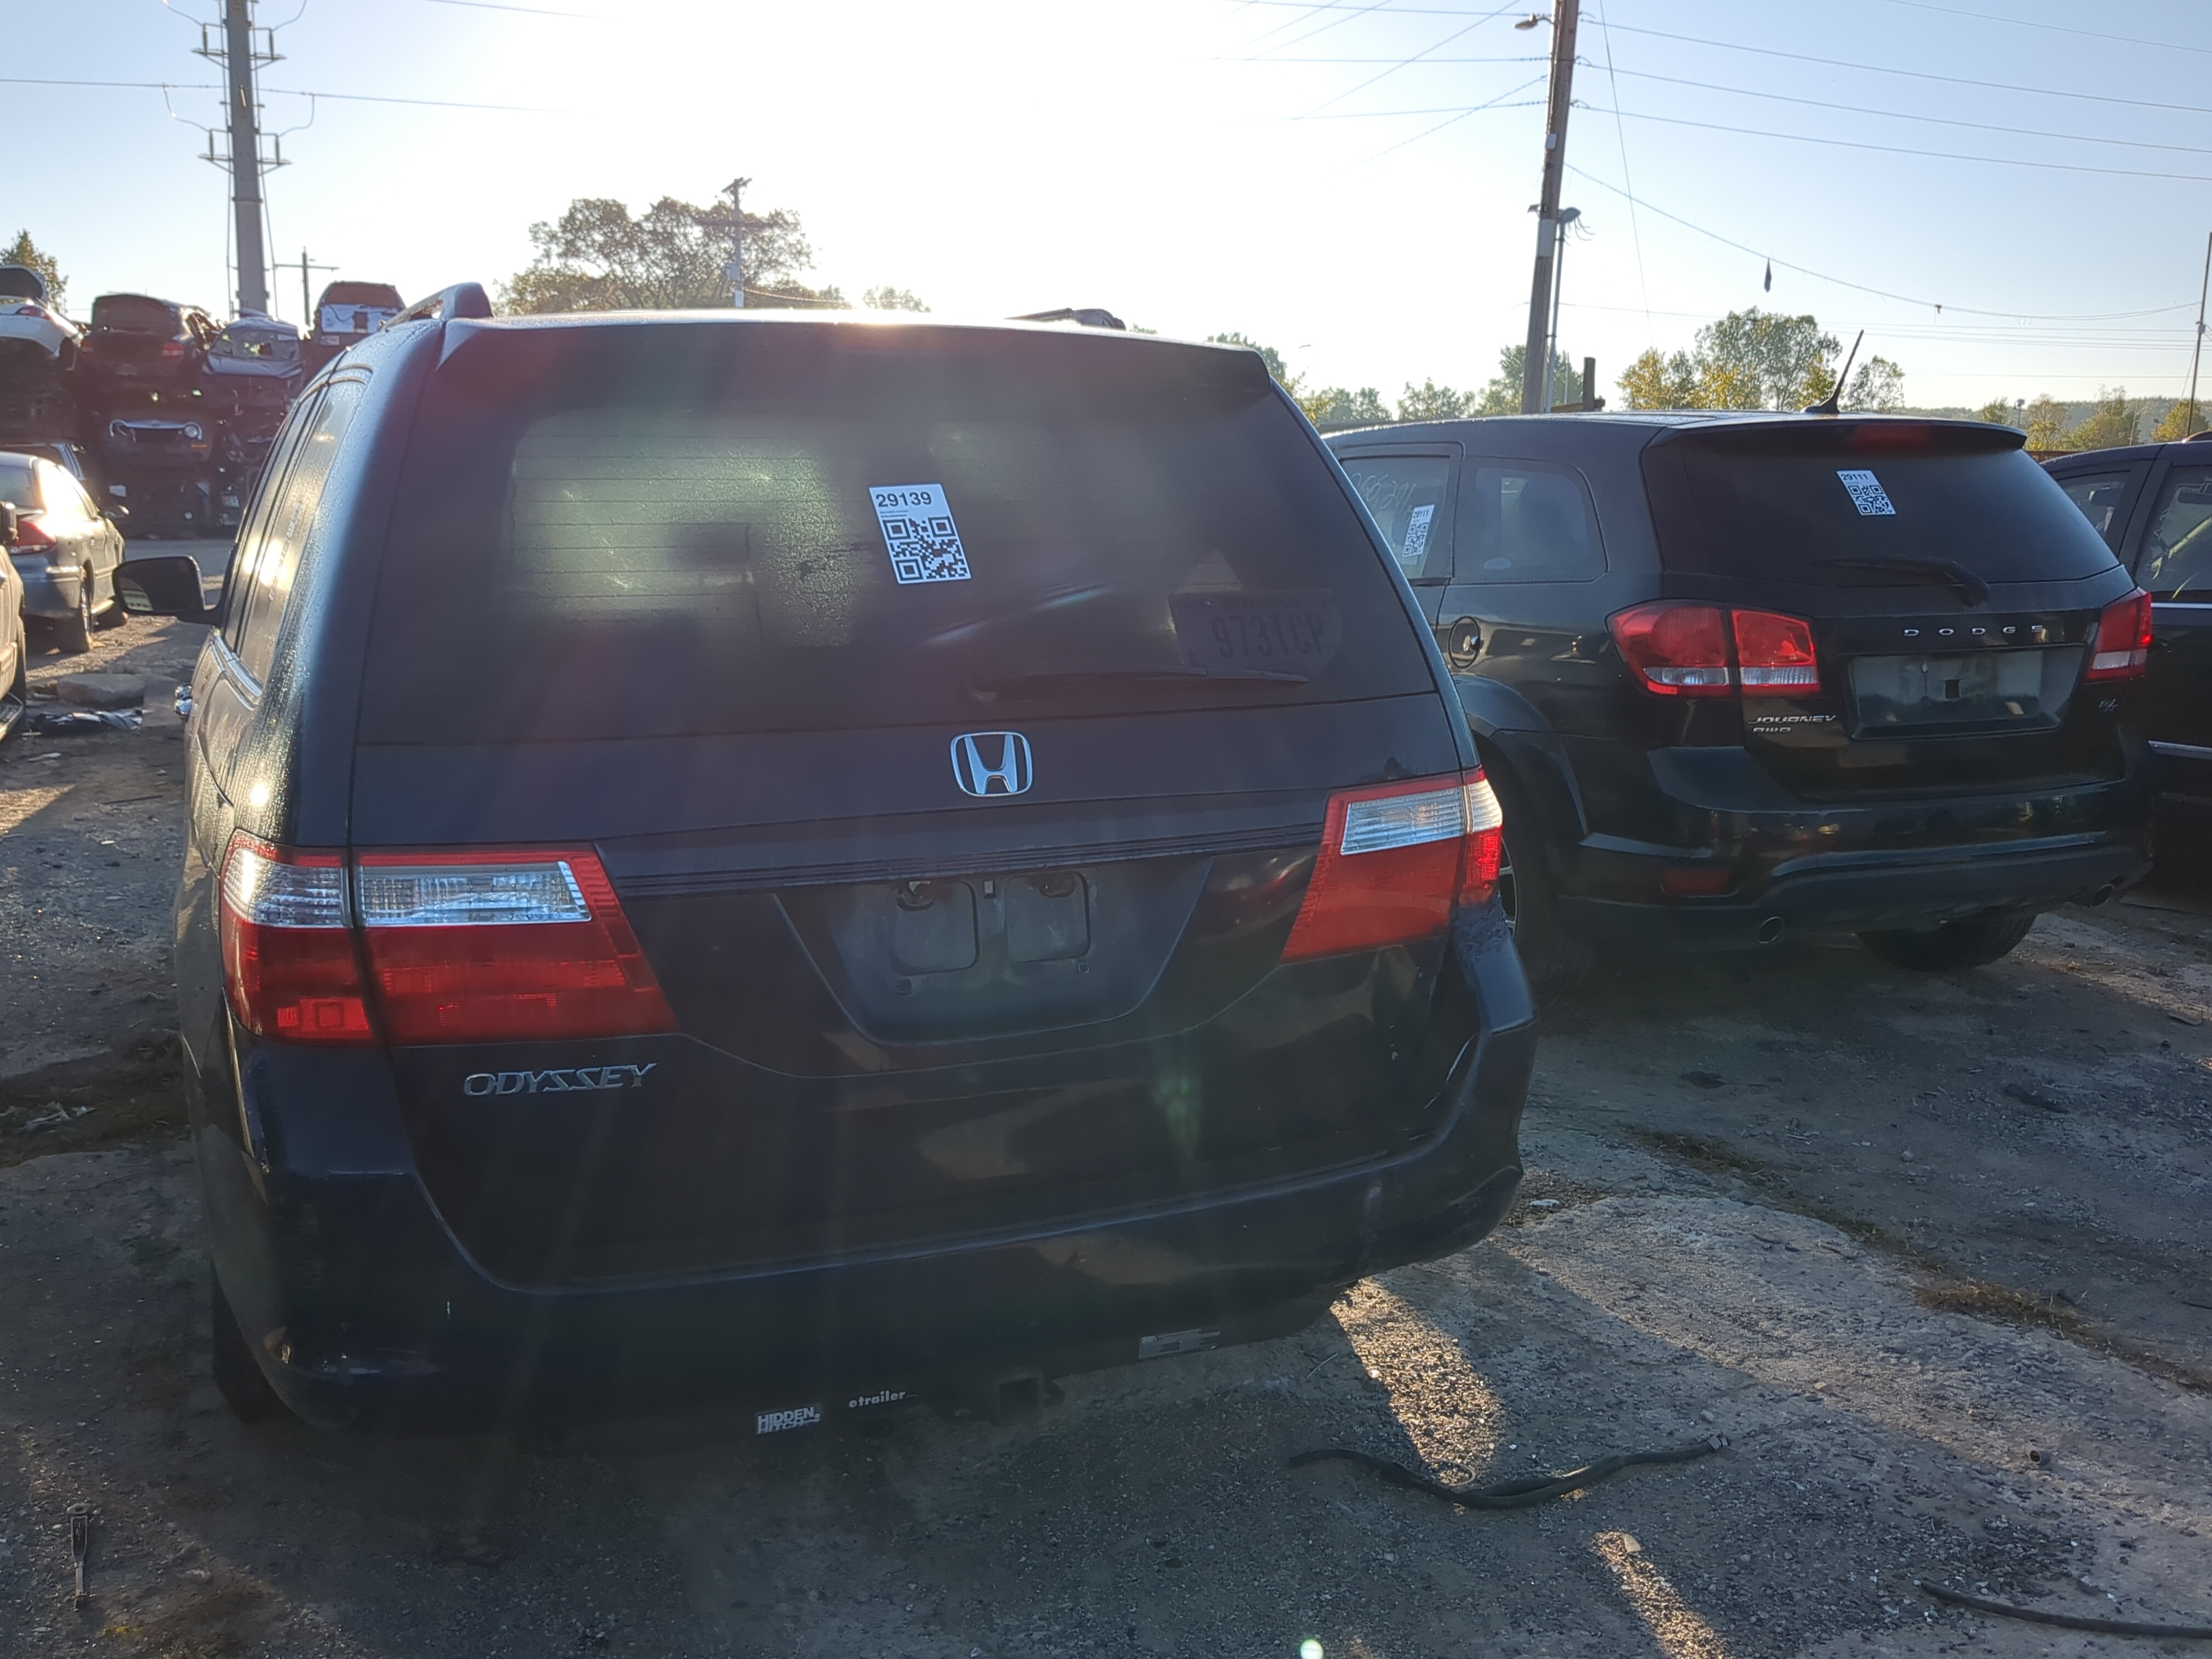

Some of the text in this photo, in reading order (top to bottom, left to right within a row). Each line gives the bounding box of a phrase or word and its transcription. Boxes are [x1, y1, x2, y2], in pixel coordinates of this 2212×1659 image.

[876, 492, 933, 507] 29139
[1904, 625, 2043, 636] DODGE
[1747, 715, 1837, 724] JOURNEY
[464, 1063, 657, 1096] ODYSSEY
